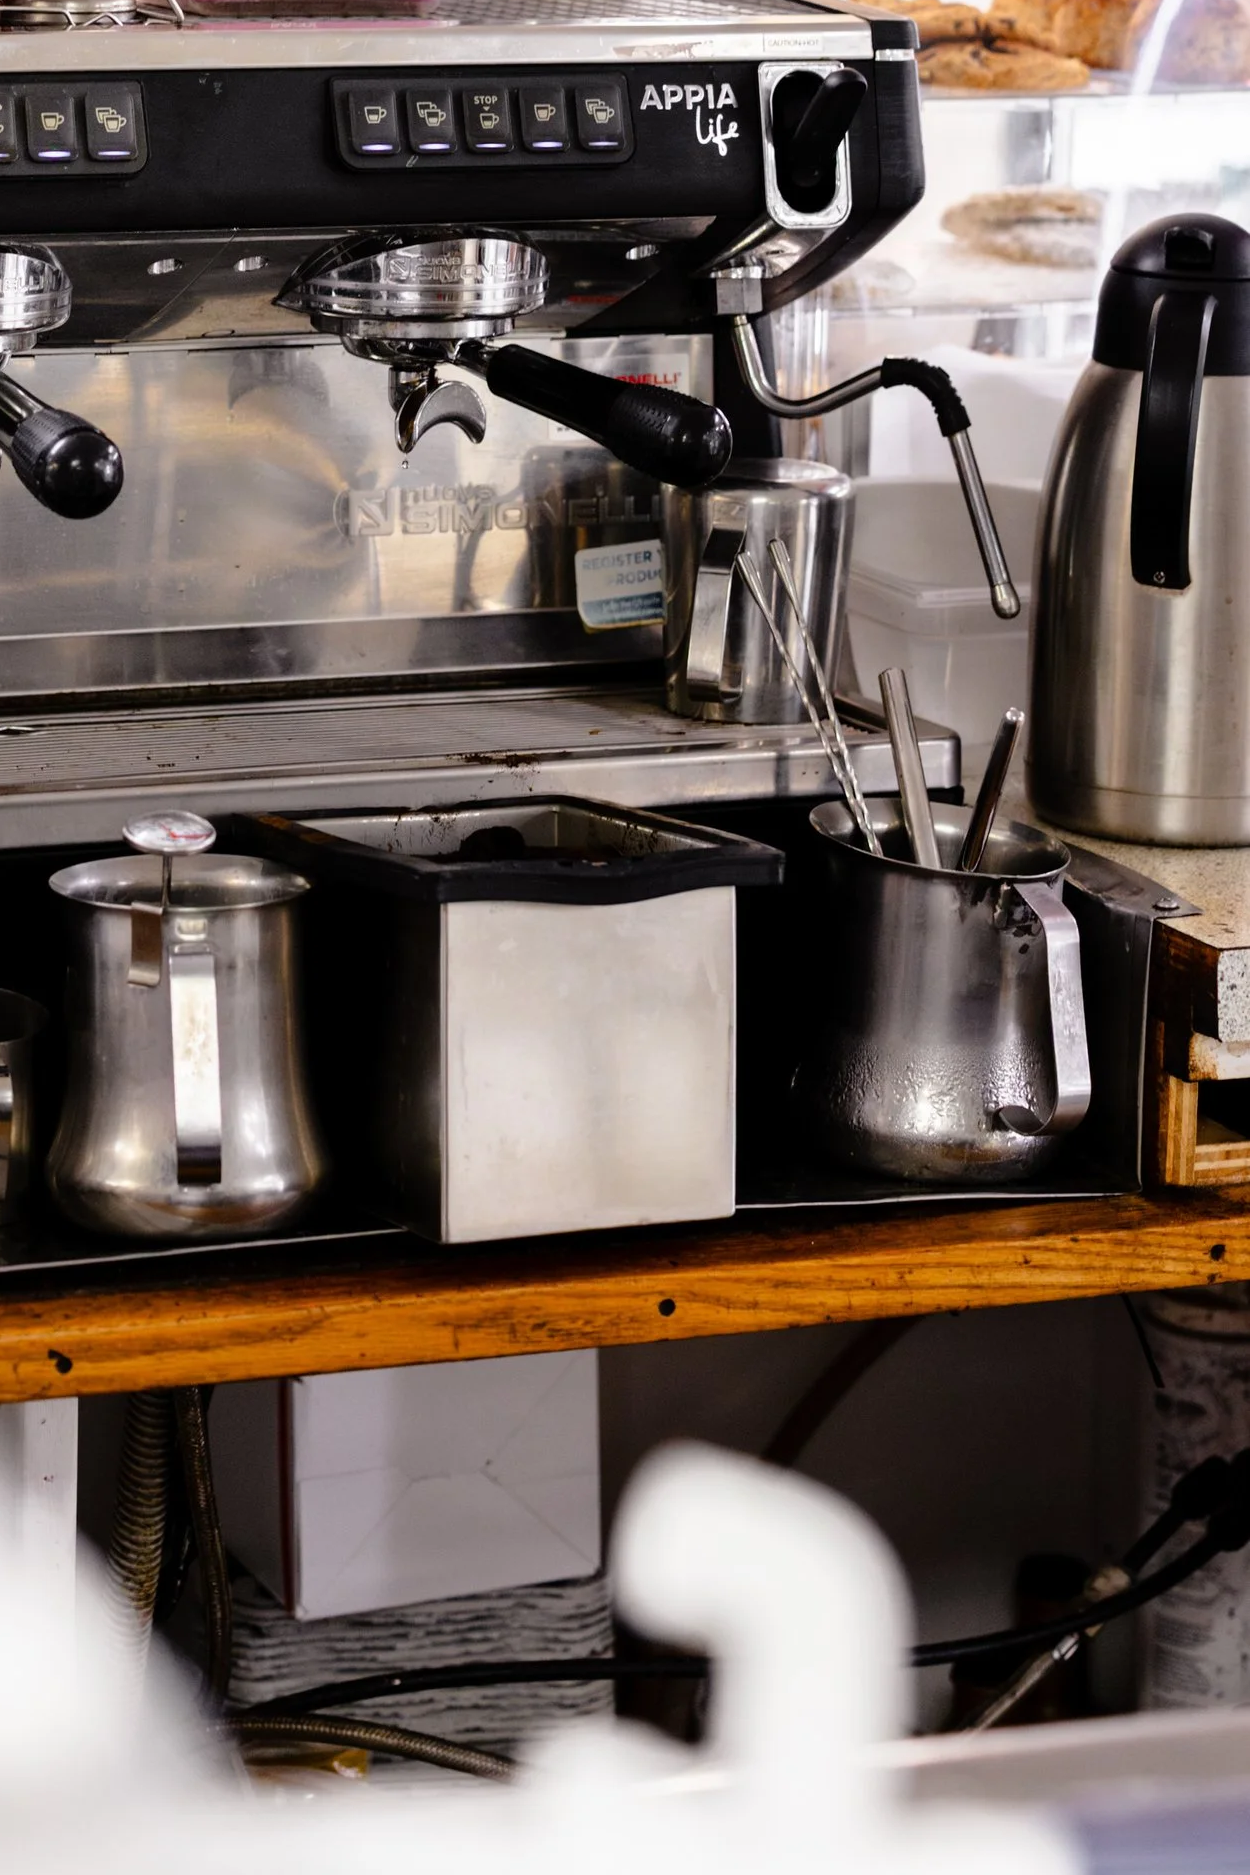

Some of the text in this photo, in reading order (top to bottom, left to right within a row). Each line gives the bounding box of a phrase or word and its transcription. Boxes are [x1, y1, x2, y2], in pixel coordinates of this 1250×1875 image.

[473, 95, 498, 105] STOP
[640, 82, 738, 111] APPIA
[694, 105, 740, 157] life
[582, 549, 652, 571] REGISTER
